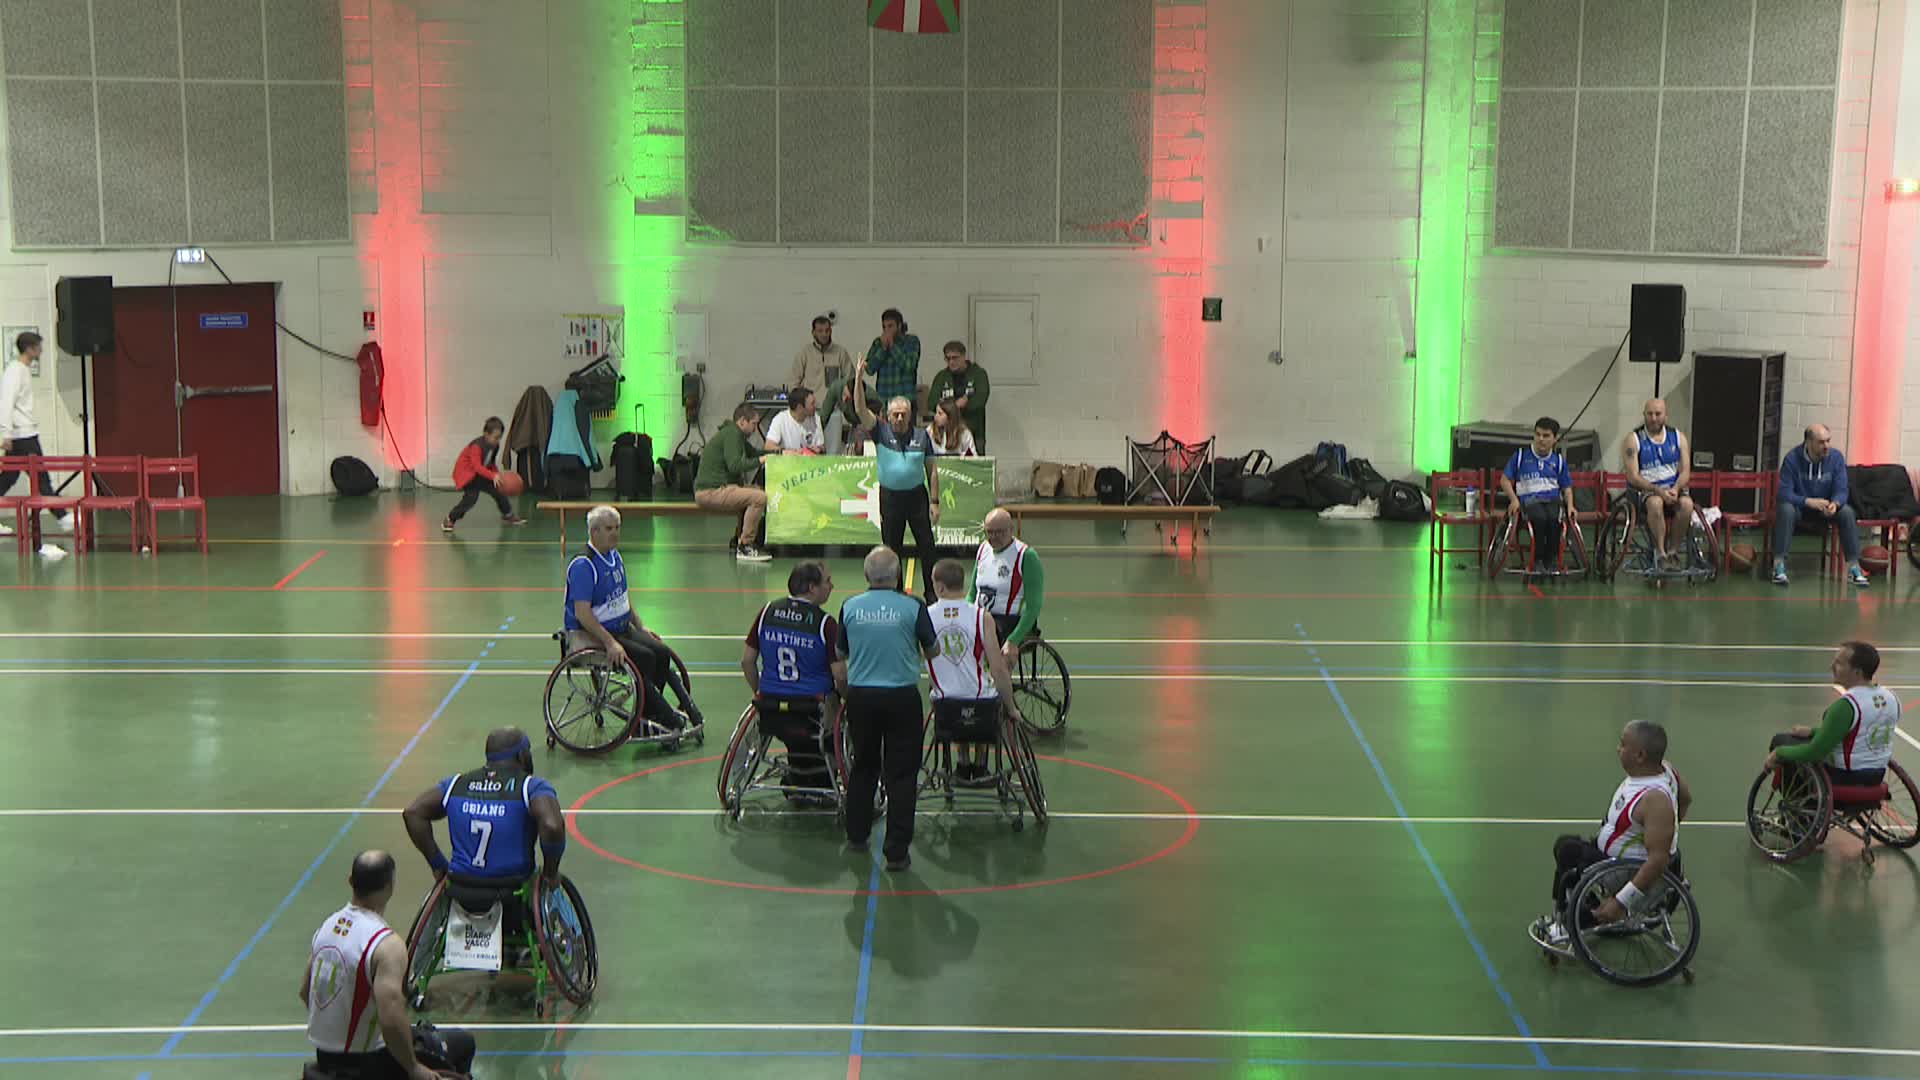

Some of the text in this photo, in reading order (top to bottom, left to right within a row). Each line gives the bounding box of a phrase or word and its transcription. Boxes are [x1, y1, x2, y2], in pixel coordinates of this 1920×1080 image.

[782, 466, 825, 491] VERTS
[773, 608, 803, 621] salto
[855, 604, 901, 622] Bastide
[764, 630, 814, 649] MARTÍNEZ
[777, 646, 799, 681] 8
[468, 779, 502, 792] salto
[462, 801, 506, 817] OBIANG
[470, 819, 492, 868] 7
[465, 939, 490, 947] VASCO
